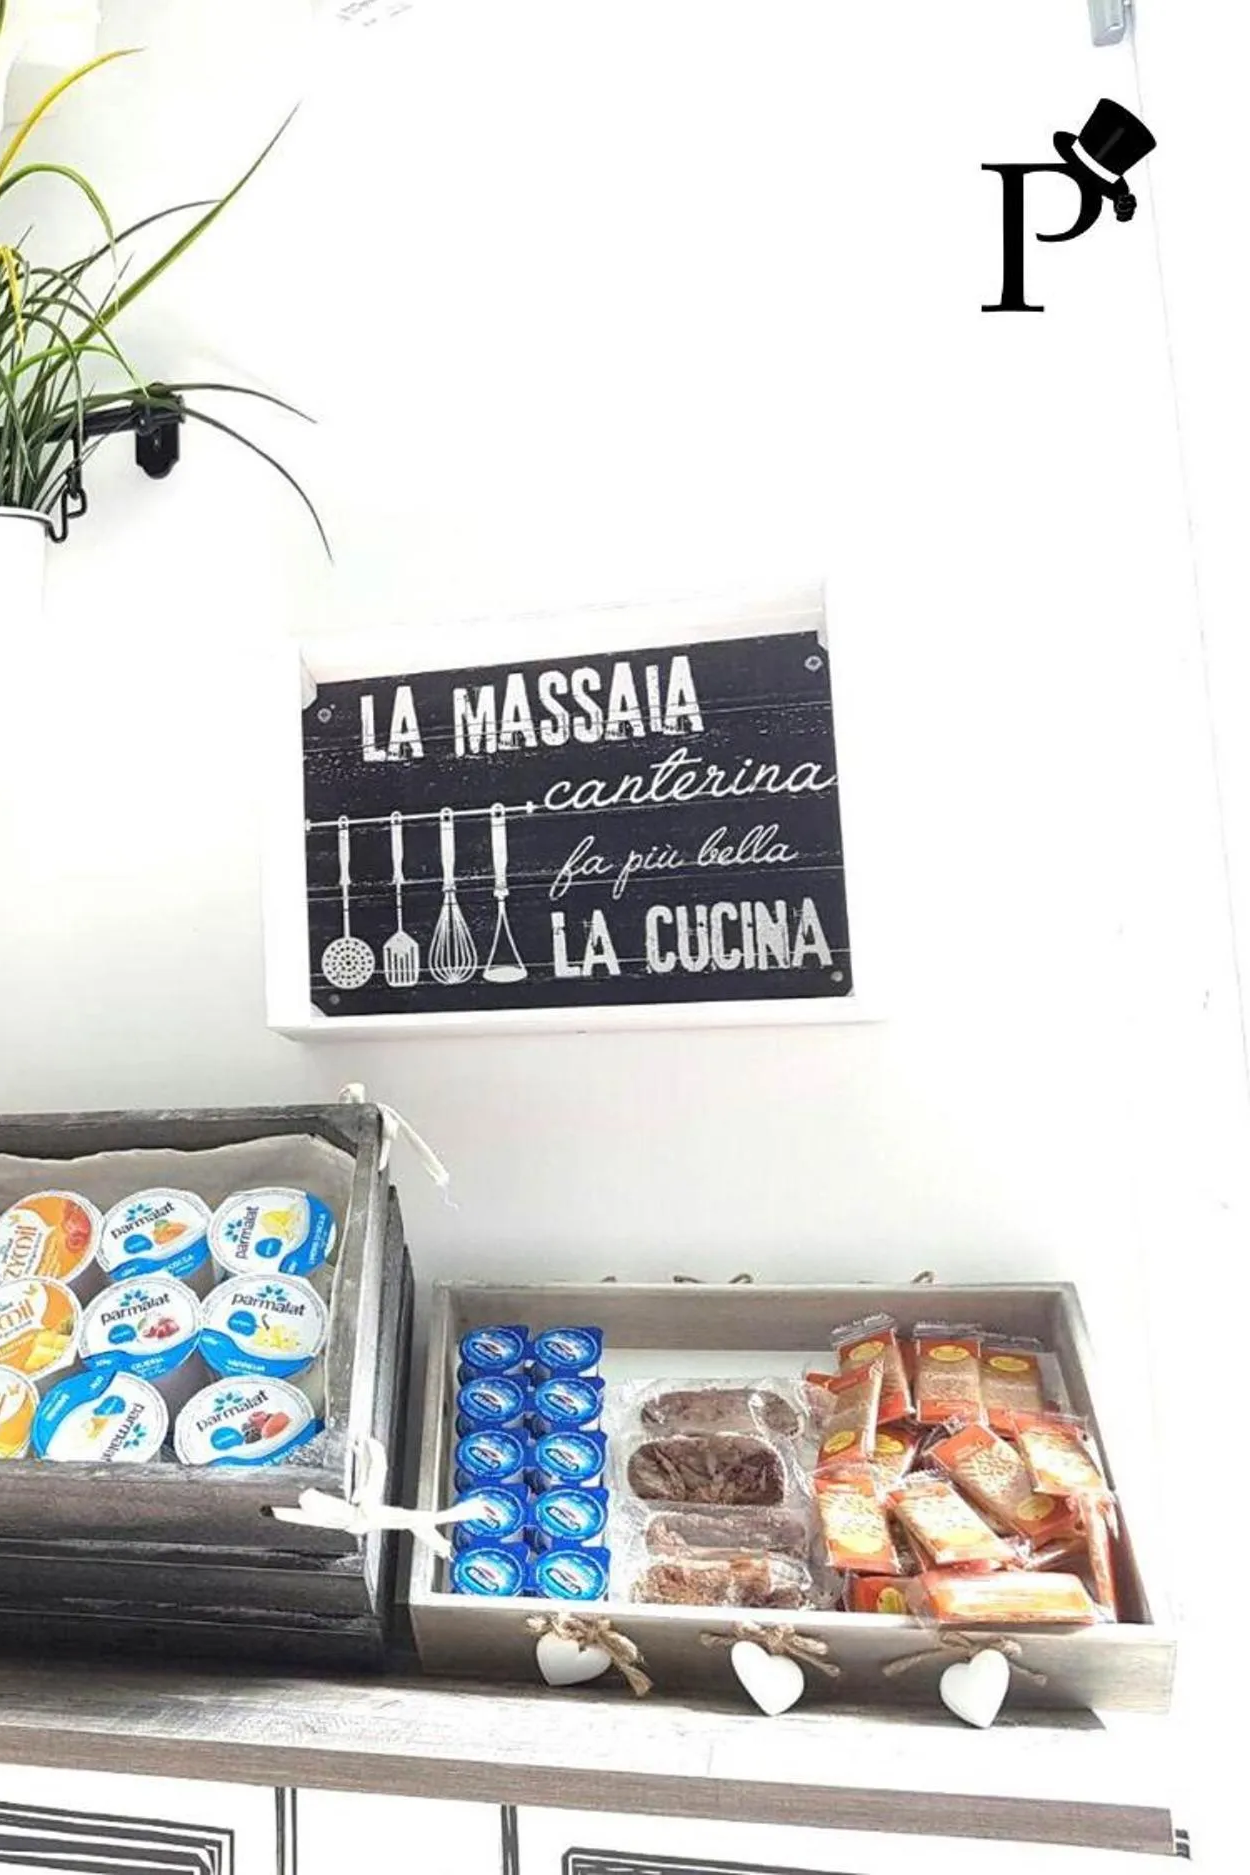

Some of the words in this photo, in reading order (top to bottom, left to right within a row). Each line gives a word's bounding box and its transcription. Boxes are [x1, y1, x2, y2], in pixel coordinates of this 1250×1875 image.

[360, 685, 424, 762] LA
[452, 655, 704, 758] MASSAIA
[544, 747, 838, 811] canterina
[550, 835, 613, 900] fa
[612, 842, 684, 899] più
[697, 824, 799, 867] bella
[551, 909, 621, 978] LA
[648, 897, 833, 975] CUCINA
[110, 1201, 175, 1240] parmalat
[235, 1205, 259, 1260] parmalat
[100, 1293, 171, 1327] parmalat
[231, 1293, 307, 1317] parmalat
[196, 1389, 270, 1432] parmalat
